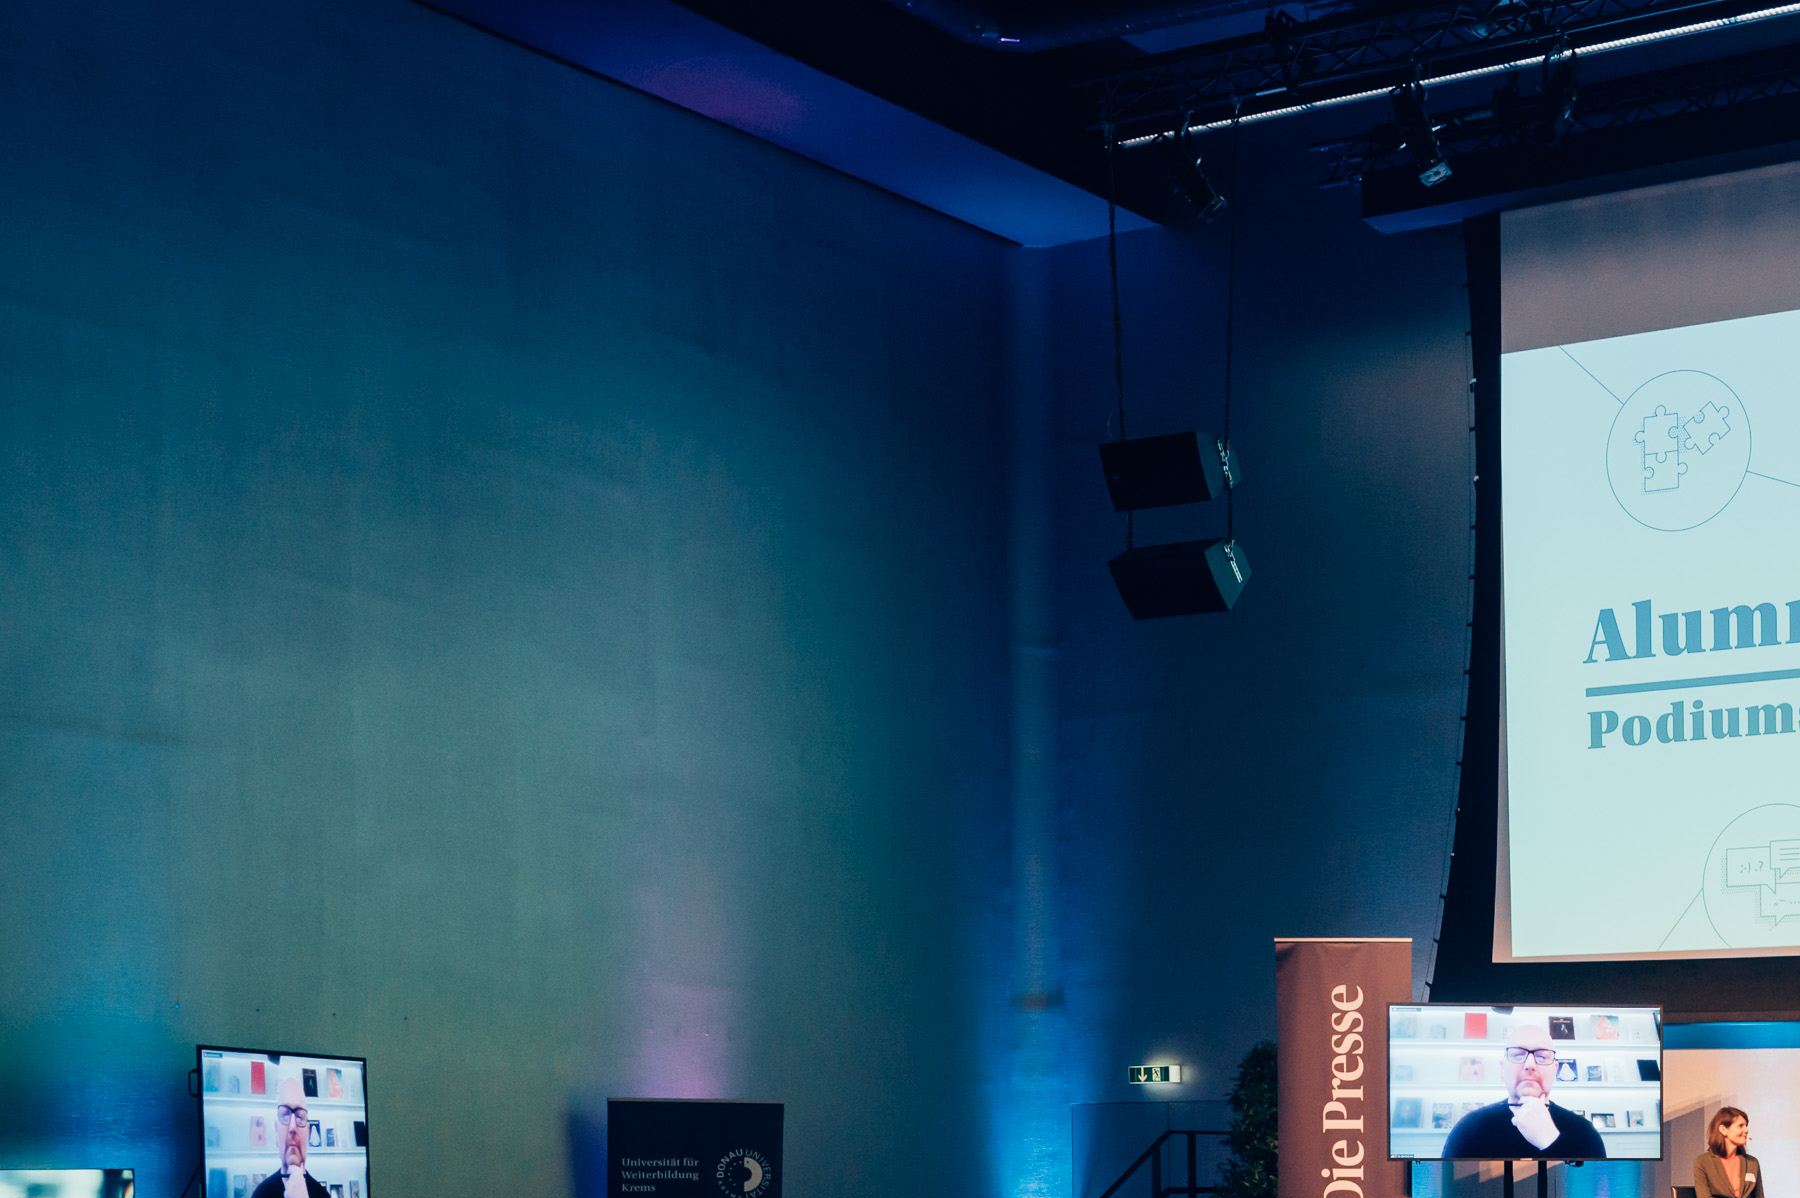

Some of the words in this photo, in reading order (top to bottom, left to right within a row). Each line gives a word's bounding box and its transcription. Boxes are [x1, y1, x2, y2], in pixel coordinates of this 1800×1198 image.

[1322, 984, 1364, 1133] Presse
[622, 1157, 680, 1167] Universität
[683, 1157, 699, 1167] für
[717, 1149, 743, 1178] DONAU
[622, 1170, 699, 1181] Weiterbildung
[622, 1183, 656, 1192] Krems
